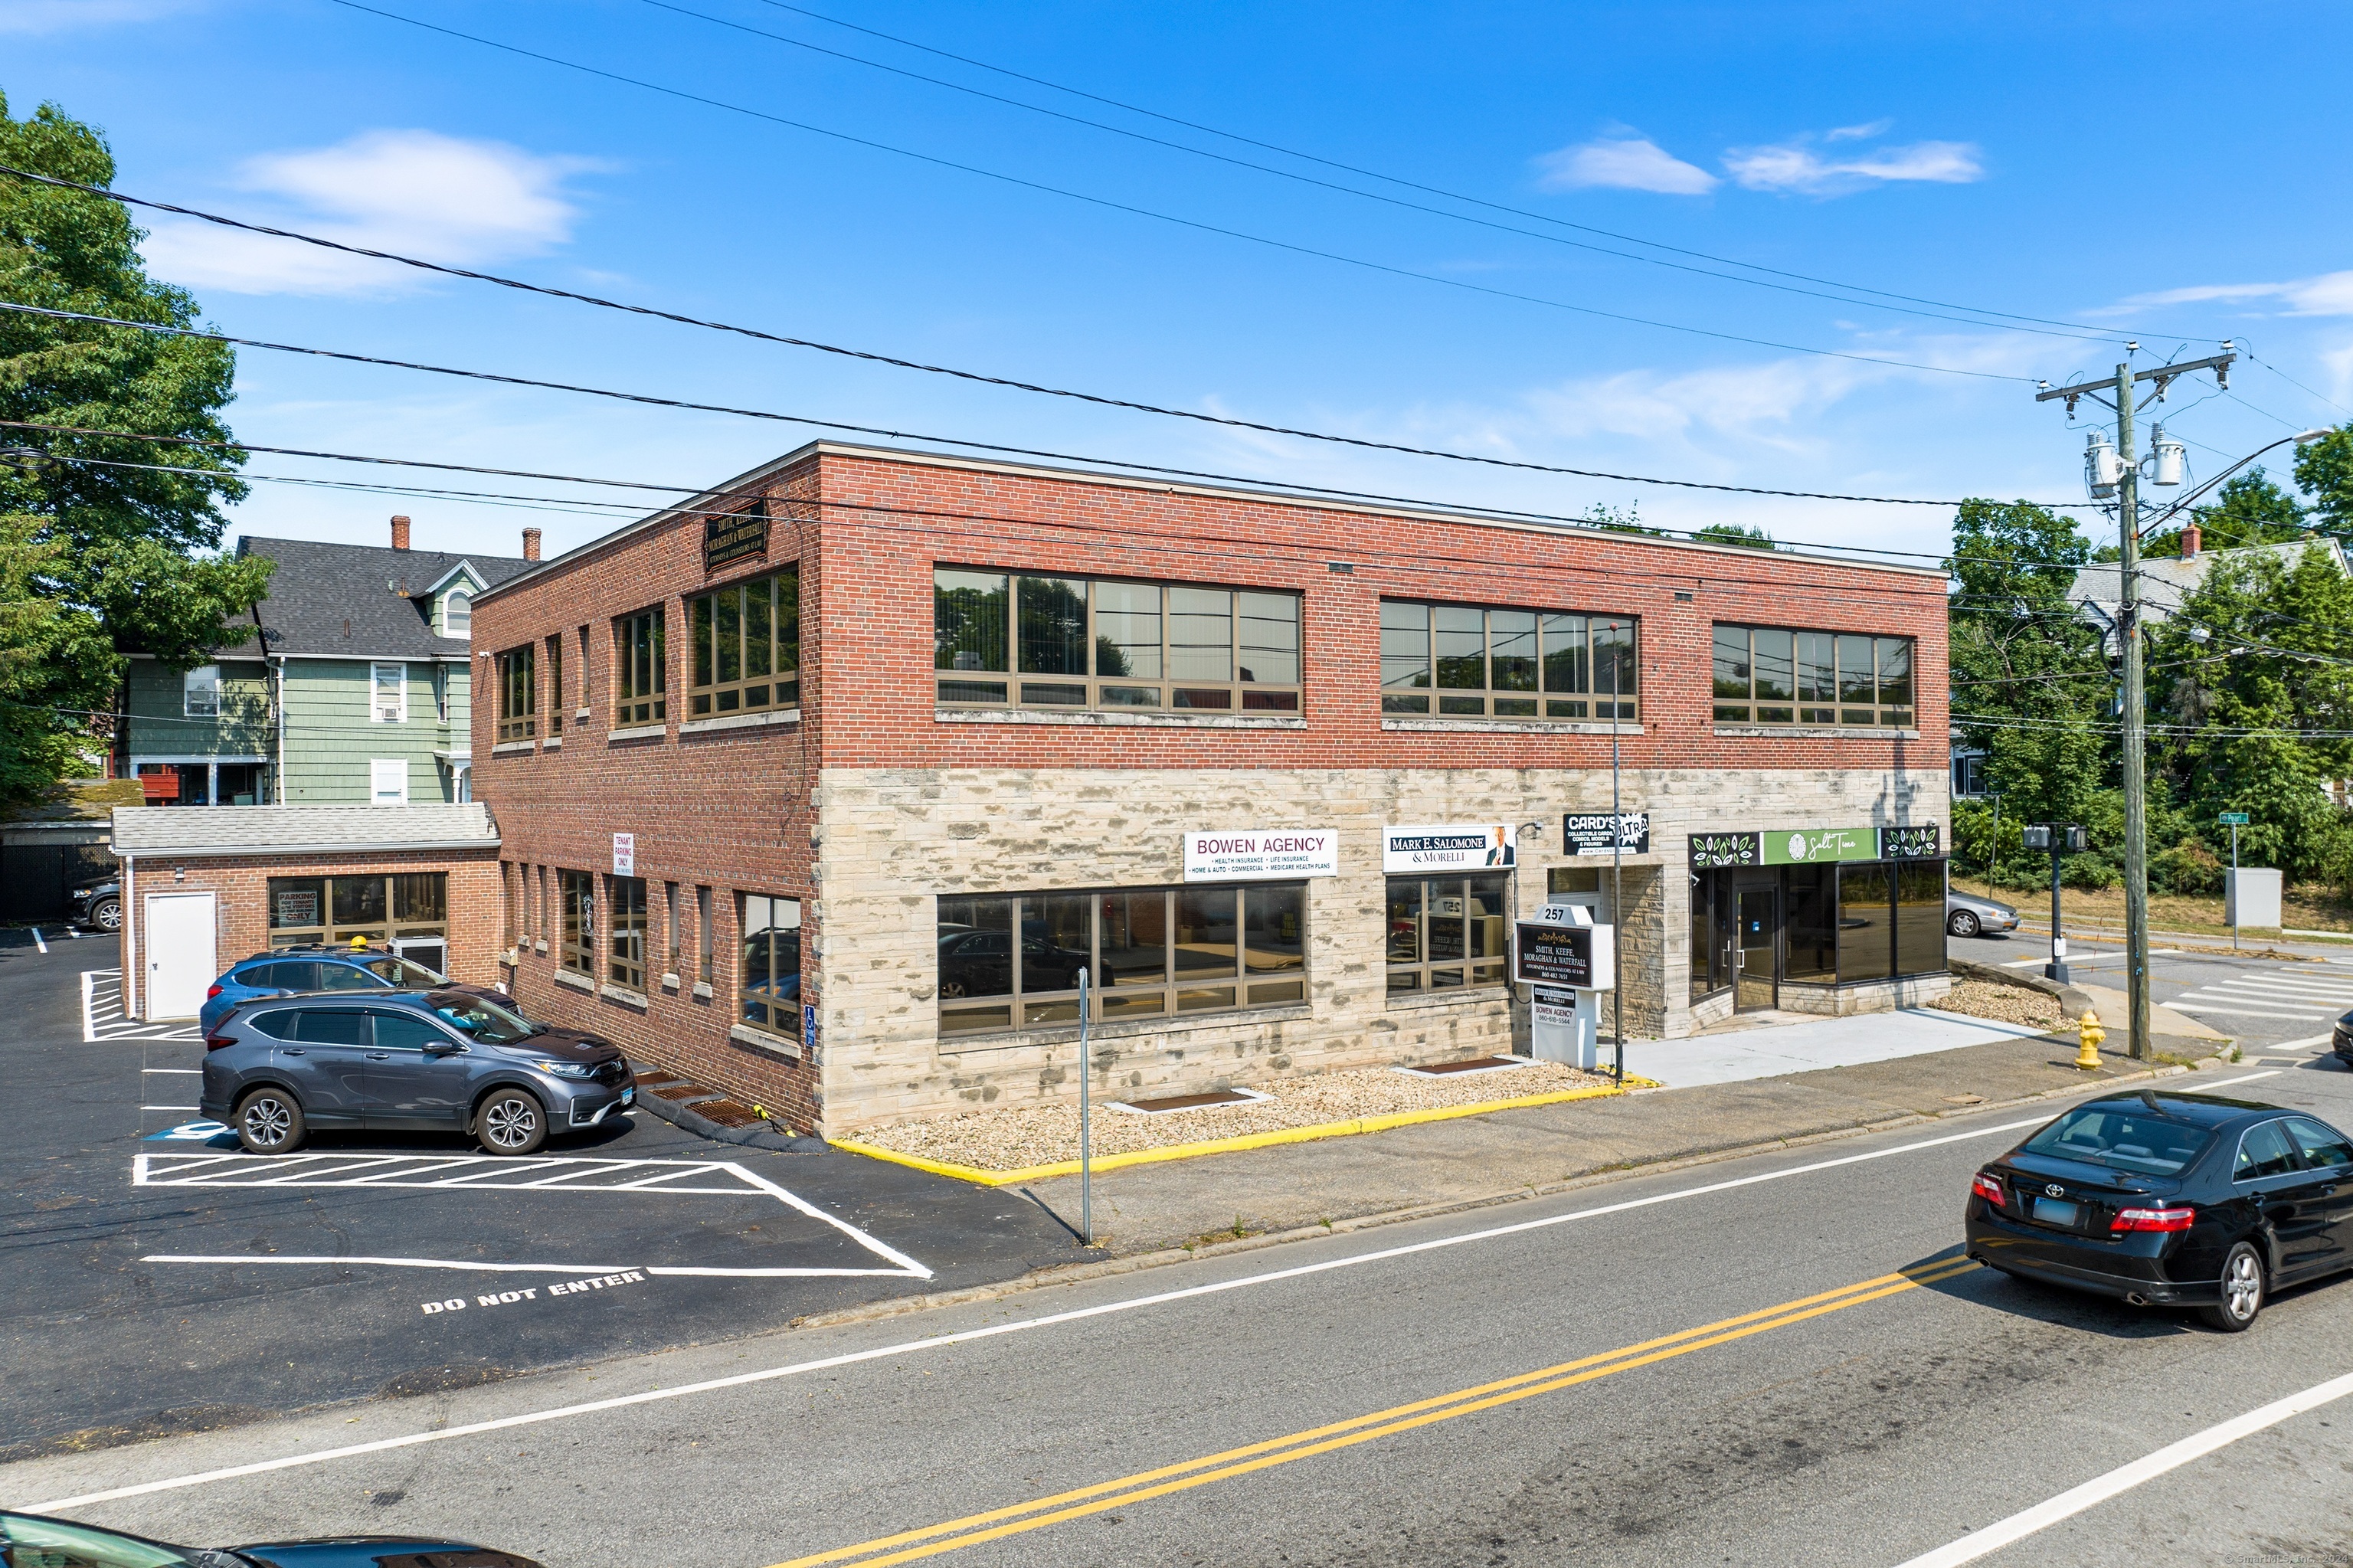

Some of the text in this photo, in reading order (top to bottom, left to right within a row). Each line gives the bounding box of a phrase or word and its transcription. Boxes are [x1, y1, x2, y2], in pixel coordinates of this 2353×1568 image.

[718, 516, 735, 532] SMITH,
[709, 532, 733, 552] MORAGHAN
[738, 521, 763, 541] WATERFALL
[729, 544, 750, 557] COUNSELORS
[1569, 816, 1615, 830] CARD'S
[2227, 814, 2242, 823] Pearl
[616, 836, 630, 845] TENANT
[1197, 837, 1324, 854] BOWEN AGENCY
[1423, 837, 1432, 849] E.
[1808, 832, 1836, 860] Salt
[615, 846, 632, 856] PARKING
[617, 857, 628, 866] ONLY
[1412, 852, 1464, 863] & MORELLI
[286, 912, 311, 921] ONLY
[1545, 908, 1564, 921] 257
[1535, 945, 1575, 957] SMITH, KEEFE,
[1523, 953, 1553, 964] MORAGHAN
[1558, 957, 1587, 967] WATERFALL
[1536, 1006, 1573, 1018] BOWEN AGENCY
[1538, 1014, 1570, 1025] 860-618-5544
[421, 1270, 646, 1315] DO NOT ENTER
